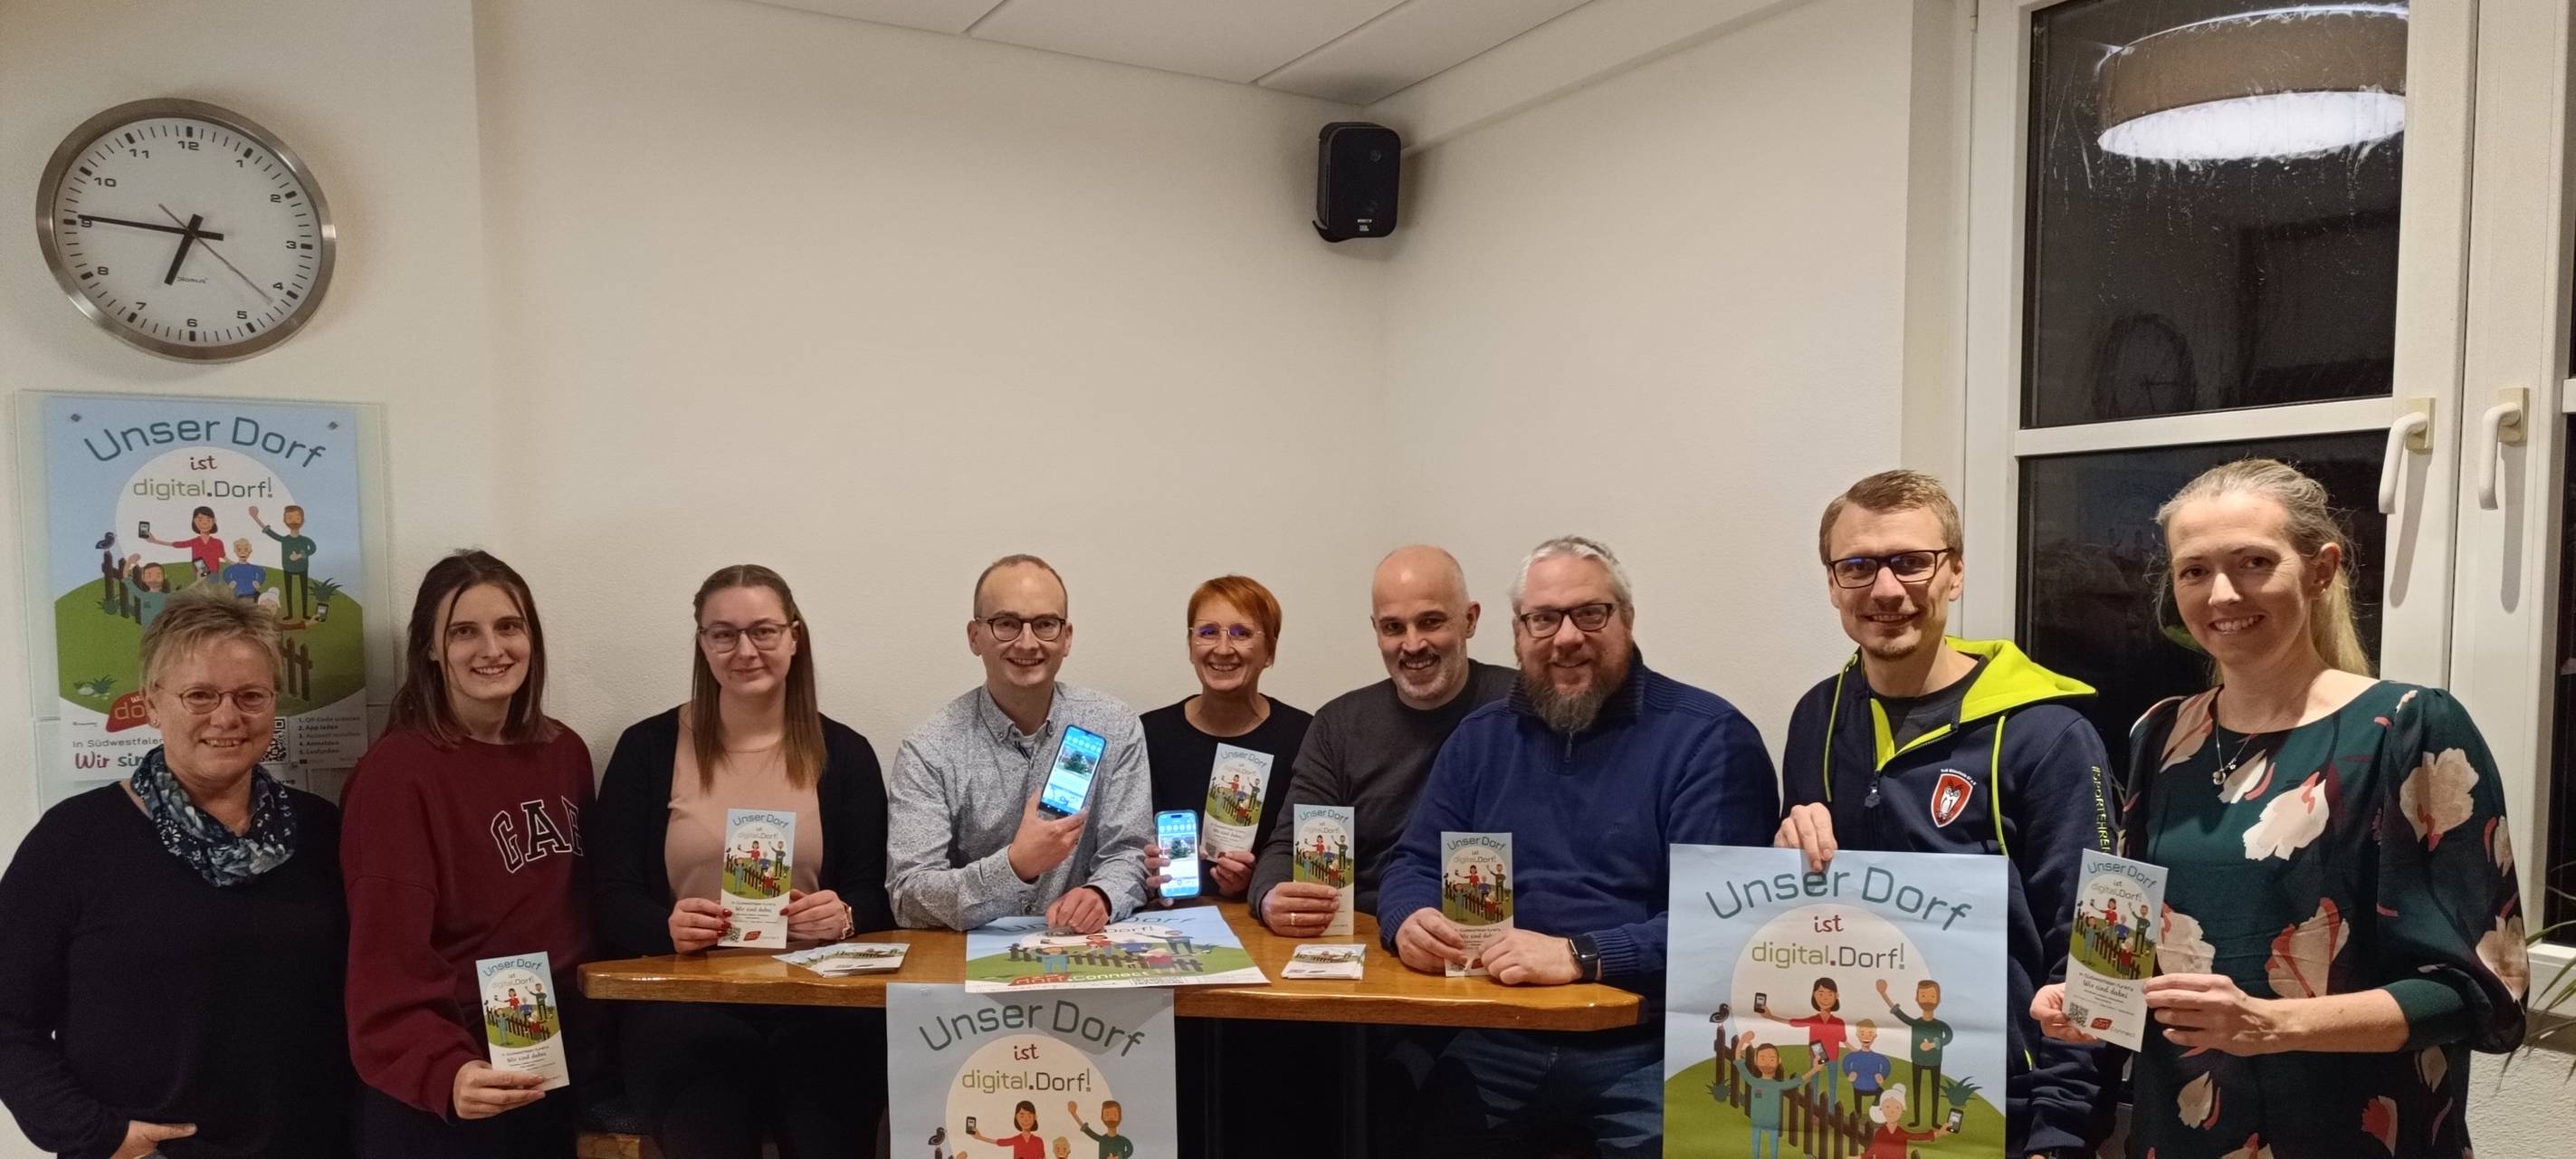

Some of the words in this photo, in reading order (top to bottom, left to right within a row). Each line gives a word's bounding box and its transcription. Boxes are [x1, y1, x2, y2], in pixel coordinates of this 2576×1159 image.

[177, 140, 200, 151] 12
[129, 149, 149, 158] 11
[235, 159, 243, 168] 1
[93, 177, 117, 187] 10
[271, 194, 281, 203] 2
[81, 217, 93, 227] 9
[286, 241, 297, 250] 3
[97, 266, 109, 276] 8
[272, 282, 284, 290] 4
[136, 302, 147, 311] 7
[236, 311, 248, 320] 5
[186, 319, 197, 327] 6
[84, 419, 221, 462] Unser
[232, 417, 327, 468] Dorf
[190, 455, 217, 471] ist
[133, 478, 273, 500] digital.Dorf!
[75, 751, 110, 770] Wir
[117, 752, 145, 768] sin
[732, 814, 765, 826] Unser
[767, 814, 789, 829] Dorf
[1300, 809, 1327, 820] Unser
[1328, 809, 1349, 823] Dorf
[1447, 838, 1481, 850] Unser
[1482, 837, 1506, 850] Dorf
[2087, 862, 2126, 874] Unser
[2127, 865, 2158, 888] Dorf
[1706, 872, 1850, 920] Unser
[1862, 867, 1972, 931] Dorf
[1814, 915, 1844, 933] ist
[1751, 942, 1905, 970] digital.Dorf!
[483, 960, 514, 976] Unser
[517, 958, 543, 971] Dorf
[920, 1001, 1044, 1051] Unser
[1053, 1000, 1145, 1057] Dorf
[1014, 1043, 1040, 1061] ist
[962, 1068, 1092, 1094] digital.Dorf!
